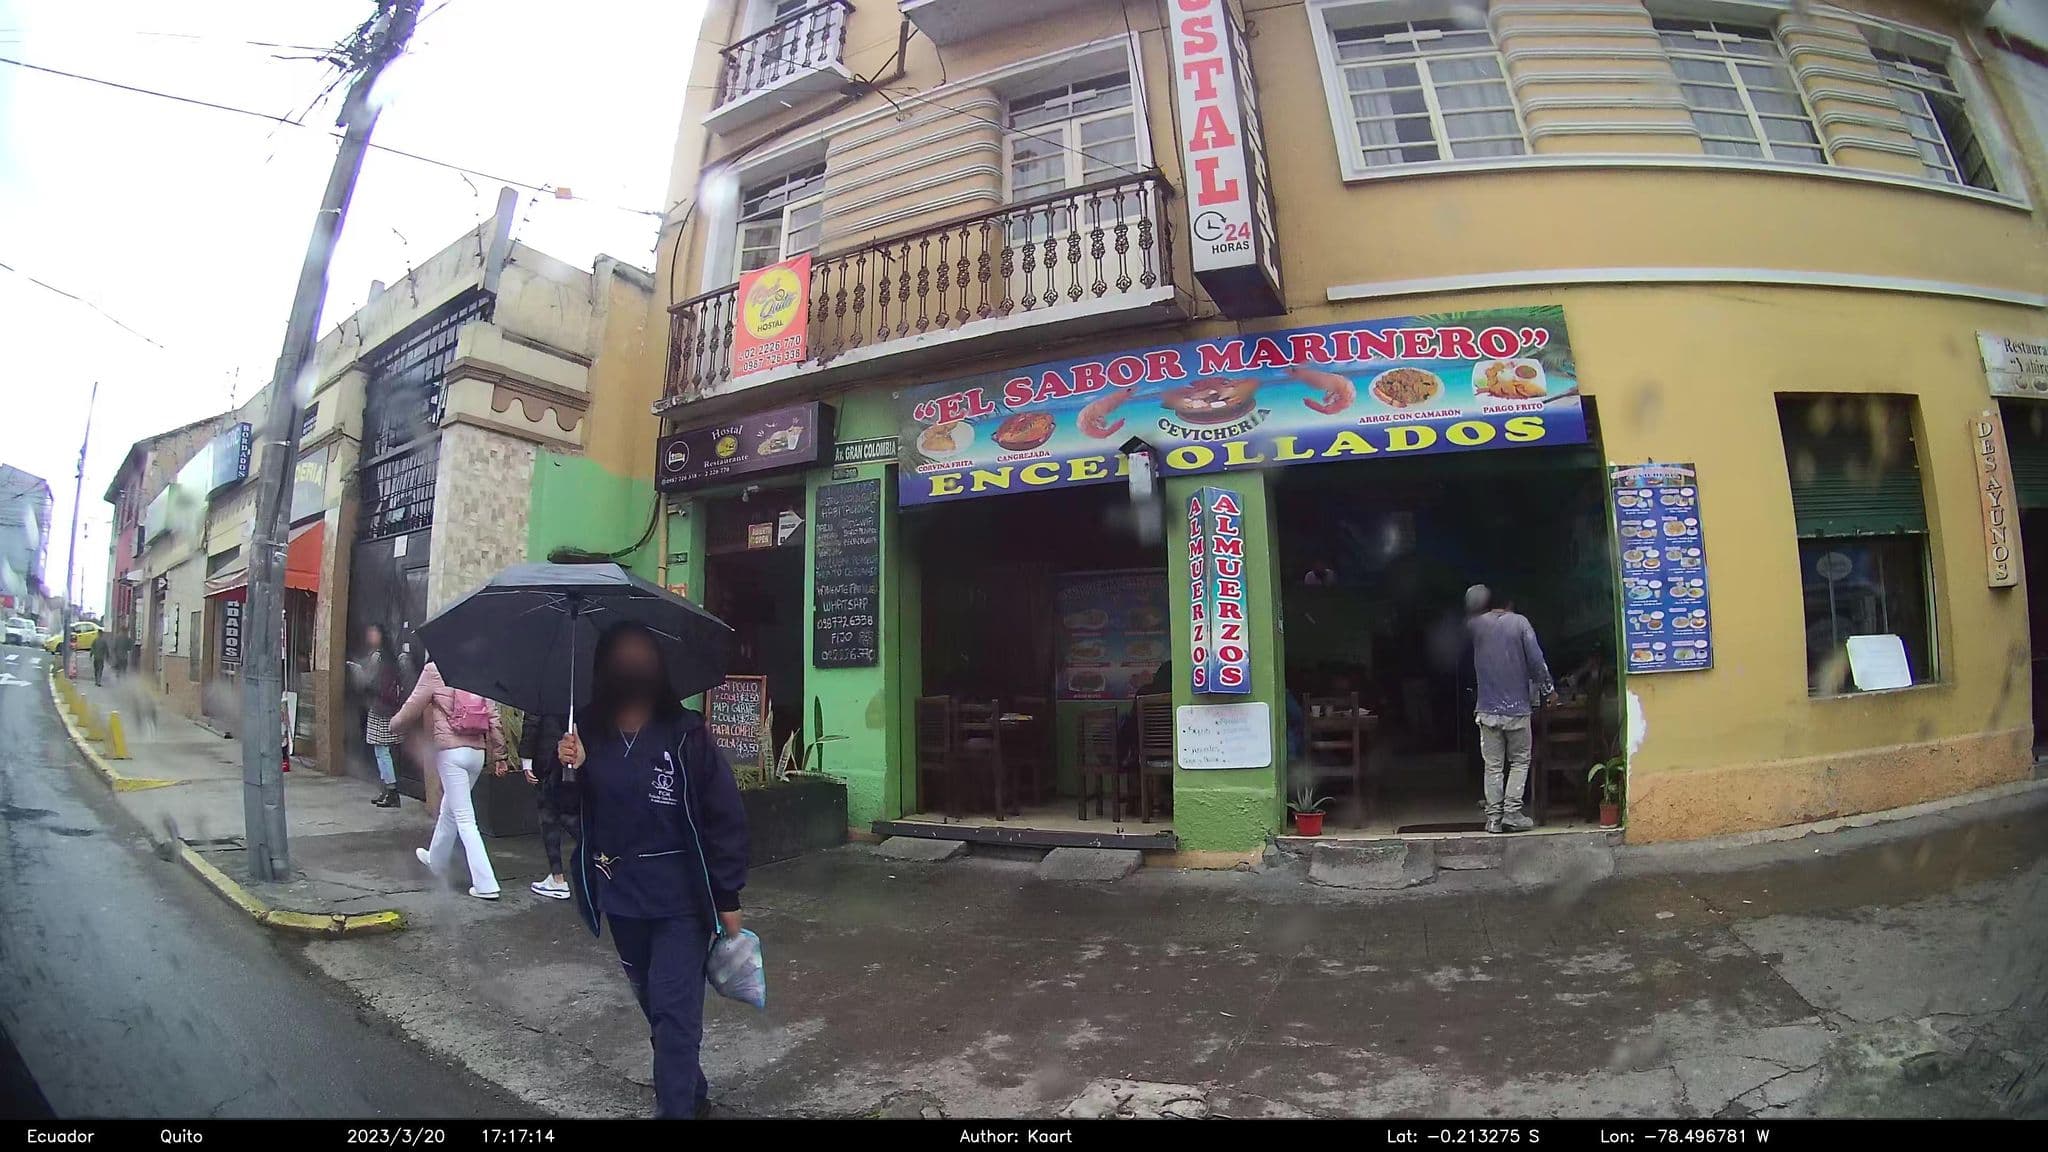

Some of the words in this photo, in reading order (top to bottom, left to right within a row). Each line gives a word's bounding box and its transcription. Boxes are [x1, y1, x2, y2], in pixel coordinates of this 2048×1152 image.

[1178, 0, 1240, 206] STAL
[1224, 222, 1251, 242] 24
[1211, 240, 1250, 255] HORAS
[757, 320, 785, 333] HOSTAL
[744, 347, 756, 359] 02
[1003, 350, 1186, 407] SABOR
[1359, 414, 1391, 424] ARROZ
[1393, 411, 1414, 421] CON
[1415, 408, 1461, 420] CAMARON
[1483, 404, 1515, 413] PARGO
[1516, 402, 1543, 412] FRITO
[711, 424, 744, 441] Hostal
[238, 424, 250, 478] BORDADOS
[845, 444, 863, 460] GRAN
[864, 440, 897, 458] COLOMBIA
[997, 450, 1050, 462] CANGREJADA
[703, 454, 750, 468] Restaurante
[917, 463, 950, 472] CORVINA
[951, 460, 974, 468] FRITA
[1977, 421, 2009, 581] DESAYUNOS
[1188, 497, 1205, 688] ALMUERZOS
[1211, 494, 1244, 686] ALMUERZOS
